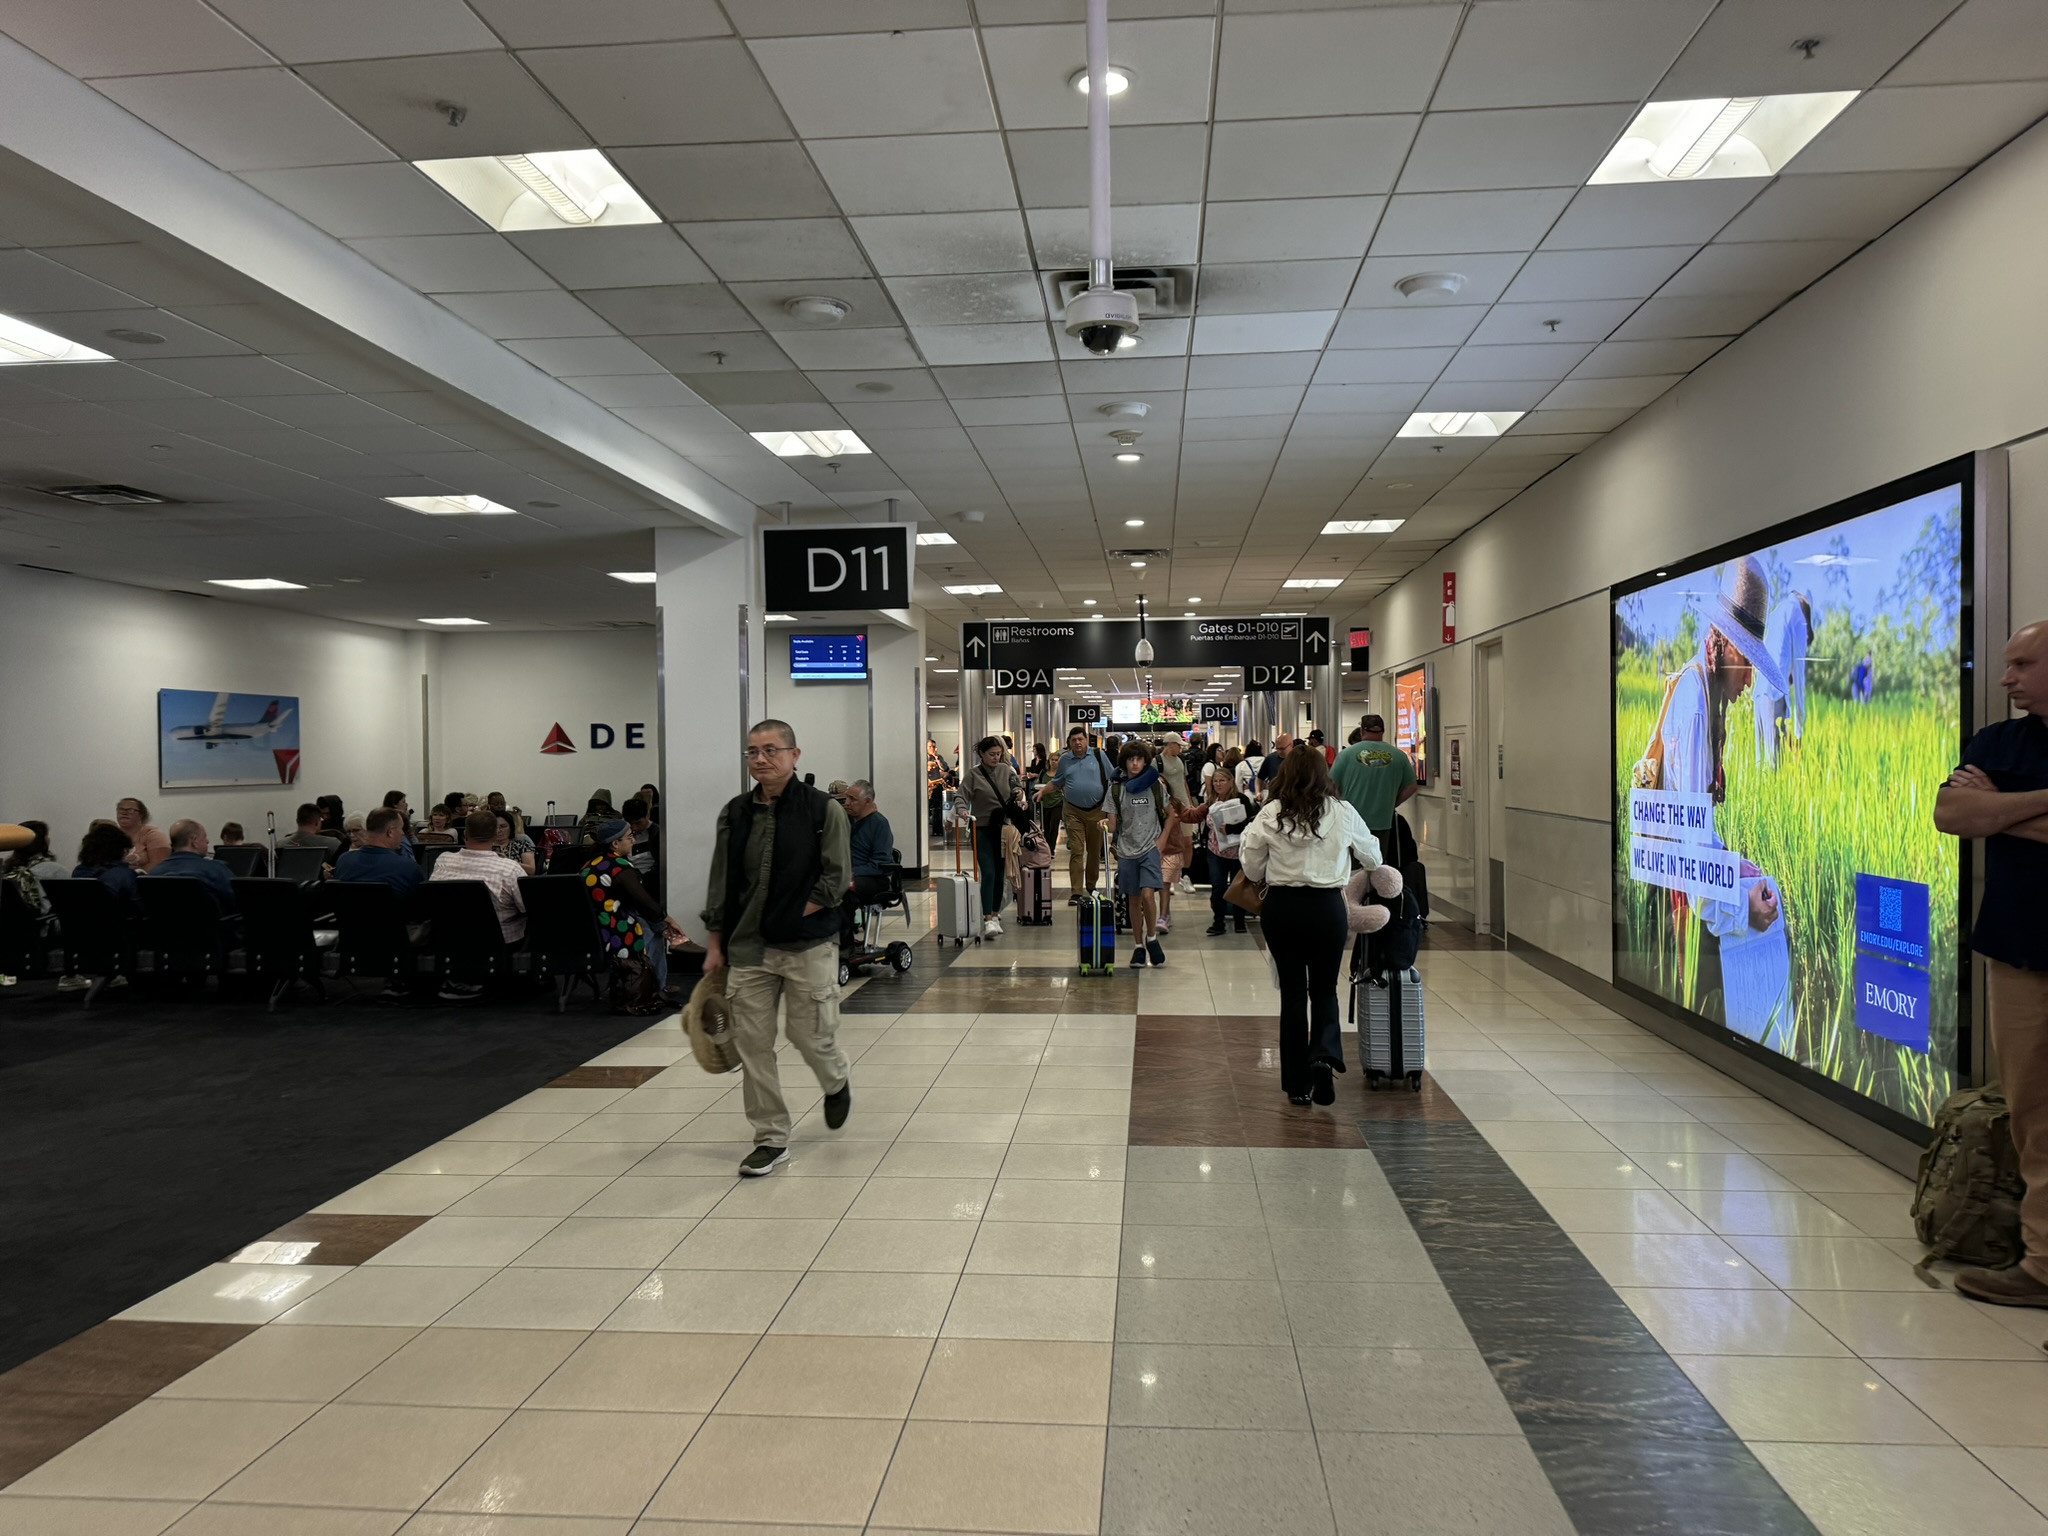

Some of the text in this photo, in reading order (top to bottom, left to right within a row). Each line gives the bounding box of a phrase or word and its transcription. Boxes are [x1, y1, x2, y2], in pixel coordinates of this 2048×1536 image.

[806, 545, 890, 593] D11
[1010, 626, 1075, 636] Restrooms
[1198, 622, 1279, 634] Gates D1-D10
[1349, 631, 1369, 648] EXIT
[997, 669, 1051, 689] D9A
[1252, 665, 1296, 685] D12
[1077, 708, 1096, 720] D9
[1205, 706, 1230, 719] D10
[1633, 800, 1707, 829] CHANGE THE WAY
[1633, 847, 1734, 889] WE LIVE IN THE WORLD
[1860, 930, 1924, 958] EMORY.EDU/EXPLORE
[1865, 981, 1918, 1019] EMORY
